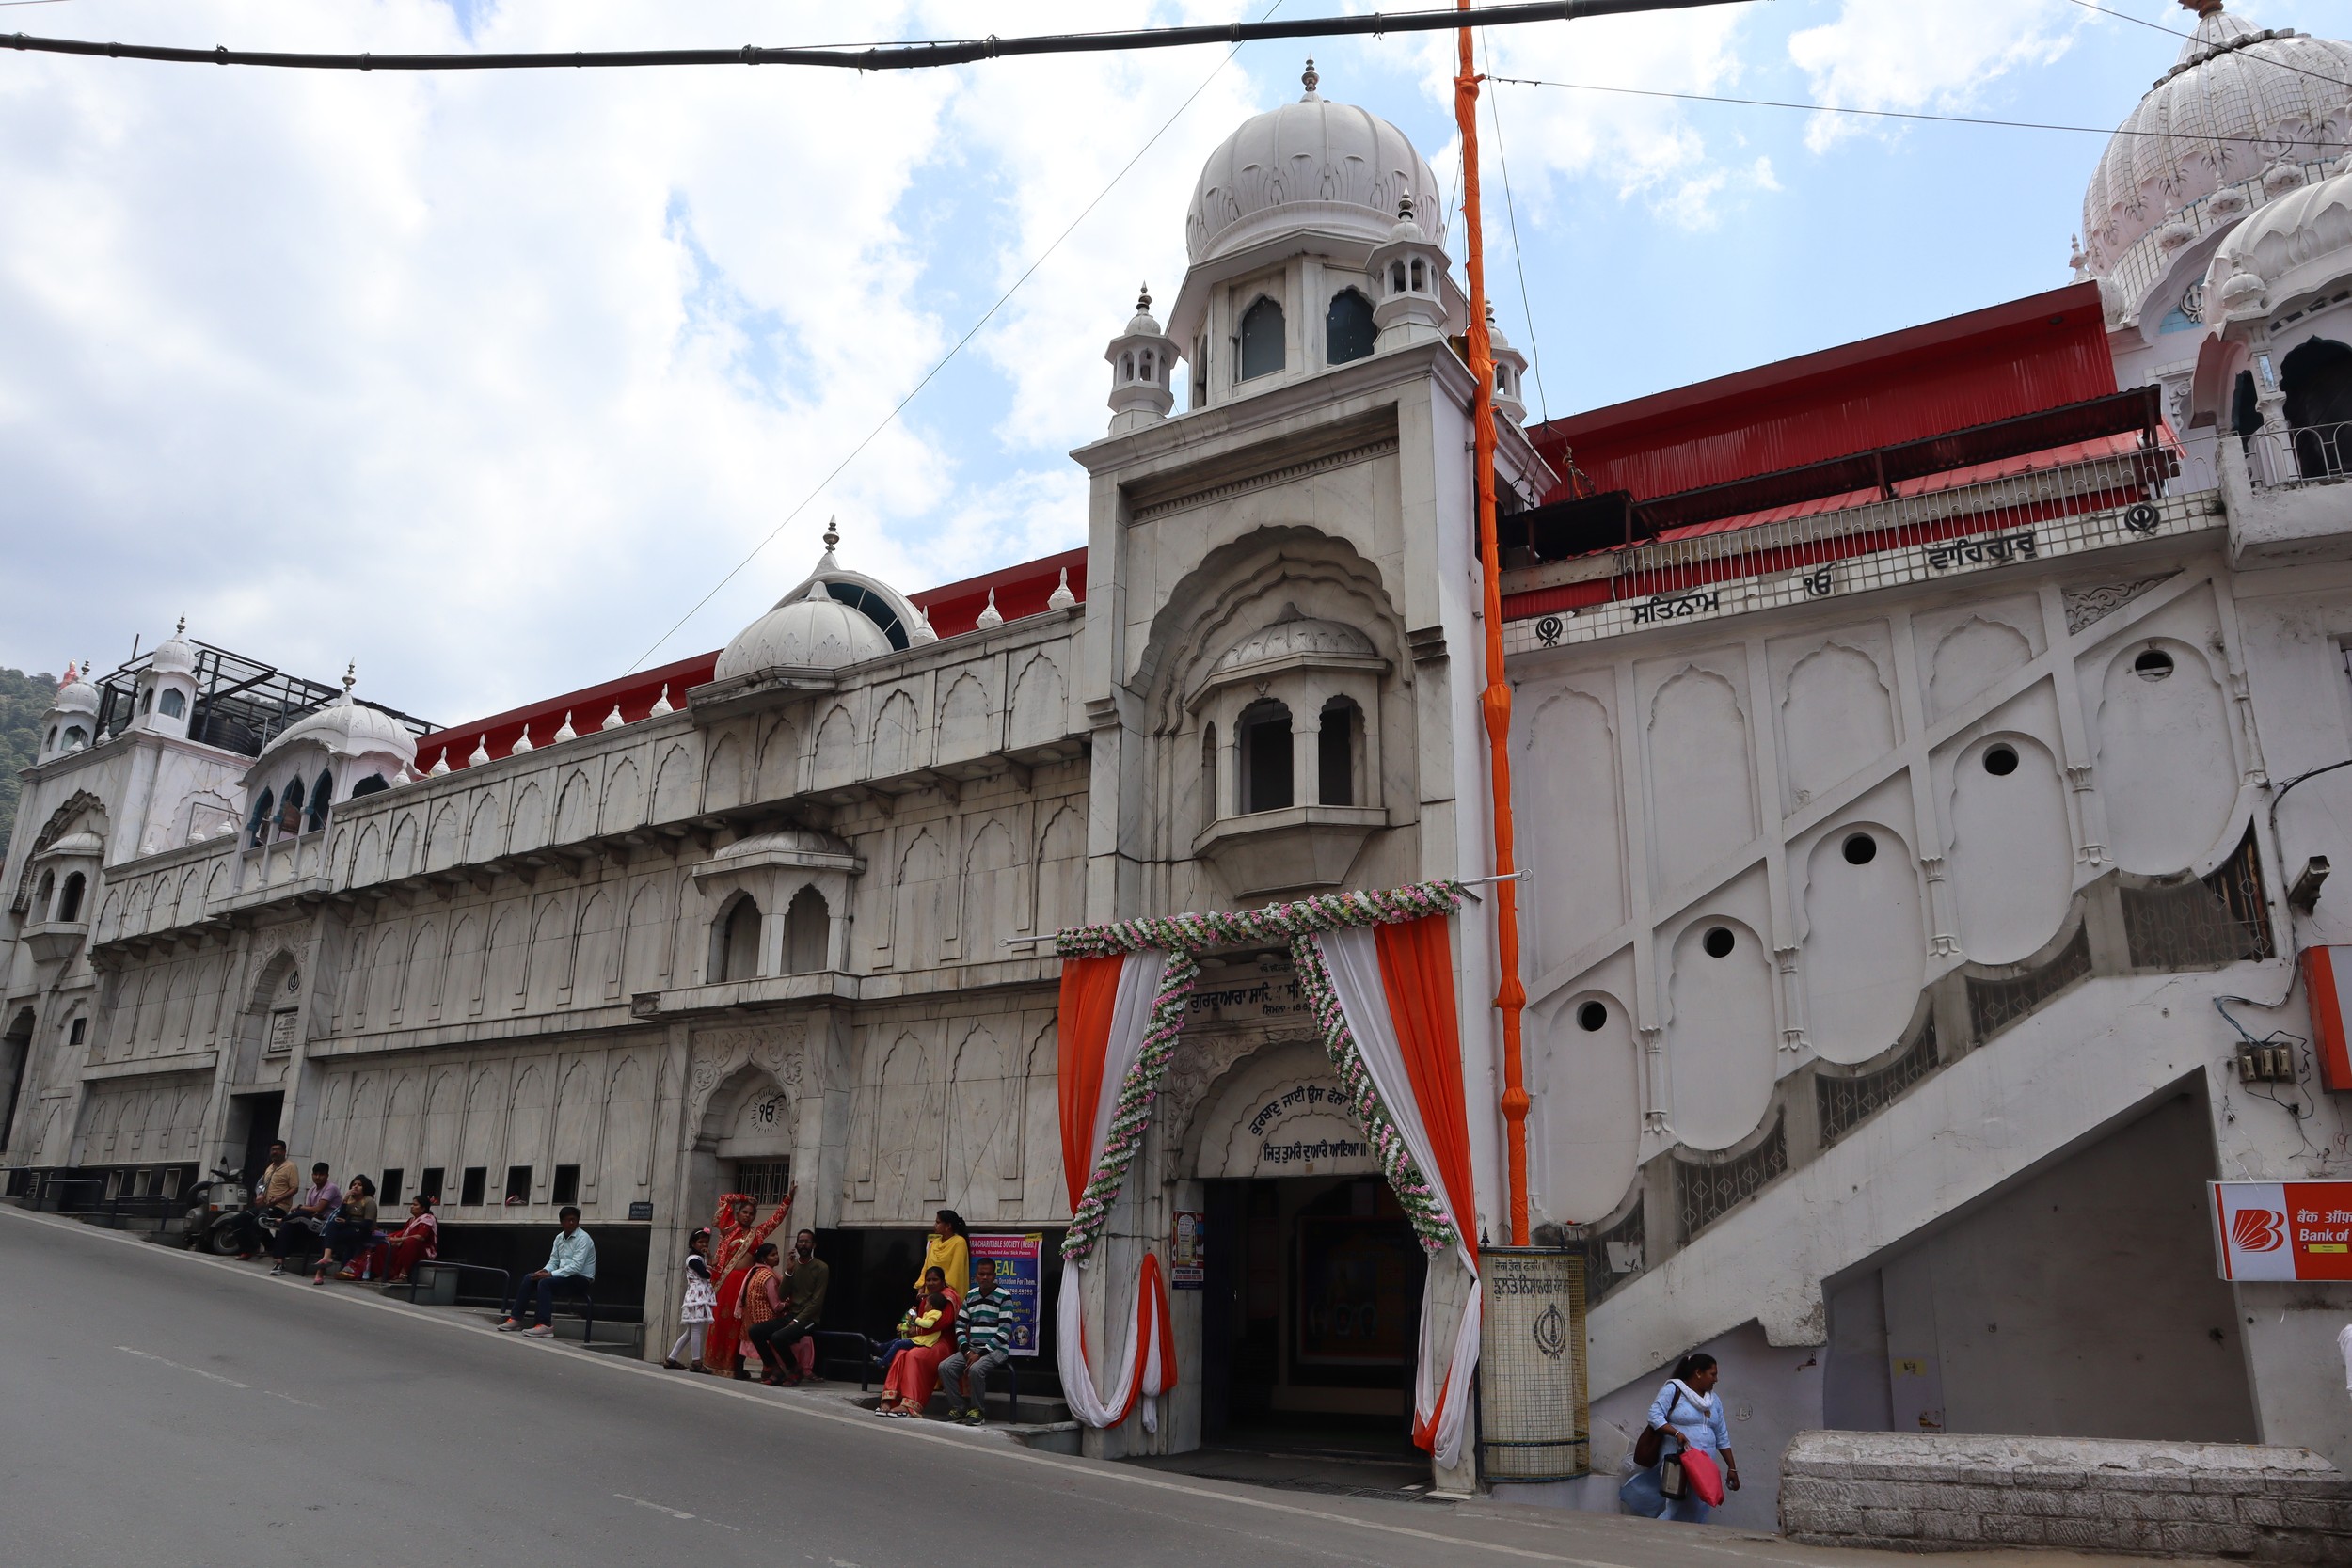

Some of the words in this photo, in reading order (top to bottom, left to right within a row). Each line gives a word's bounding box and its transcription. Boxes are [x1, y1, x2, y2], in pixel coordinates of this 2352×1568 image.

[1630, 591, 1720, 625] ਸਤਿਨਾਮ
[1190, 989, 1247, 1013] ਗੁਰਦੁਆਰਾ
[1281, 1085, 1305, 1108] ਜਾਈ
[1306, 1085, 1325, 1103] ਉਸ
[1327, 1087, 1349, 1105] ਵੇਲਾ
[1263, 1142, 1281, 1163] ਜਿਤੁ
[1281, 1141, 1302, 1163] ਤੁਮਰੈ
[1303, 1139, 1327, 1162] ਦੁਆਰੈ
[1328, 1139, 1359, 1158] ਆਇਆ
[2296, 1208, 2319, 1224] बैंक
[977, 1240, 1003, 1249] CHARITABLE
[1003, 1240, 1021, 1249] SOCIETY
[2299, 1228, 2334, 1242] Bank
[2336, 1228, 2350, 1242] of
